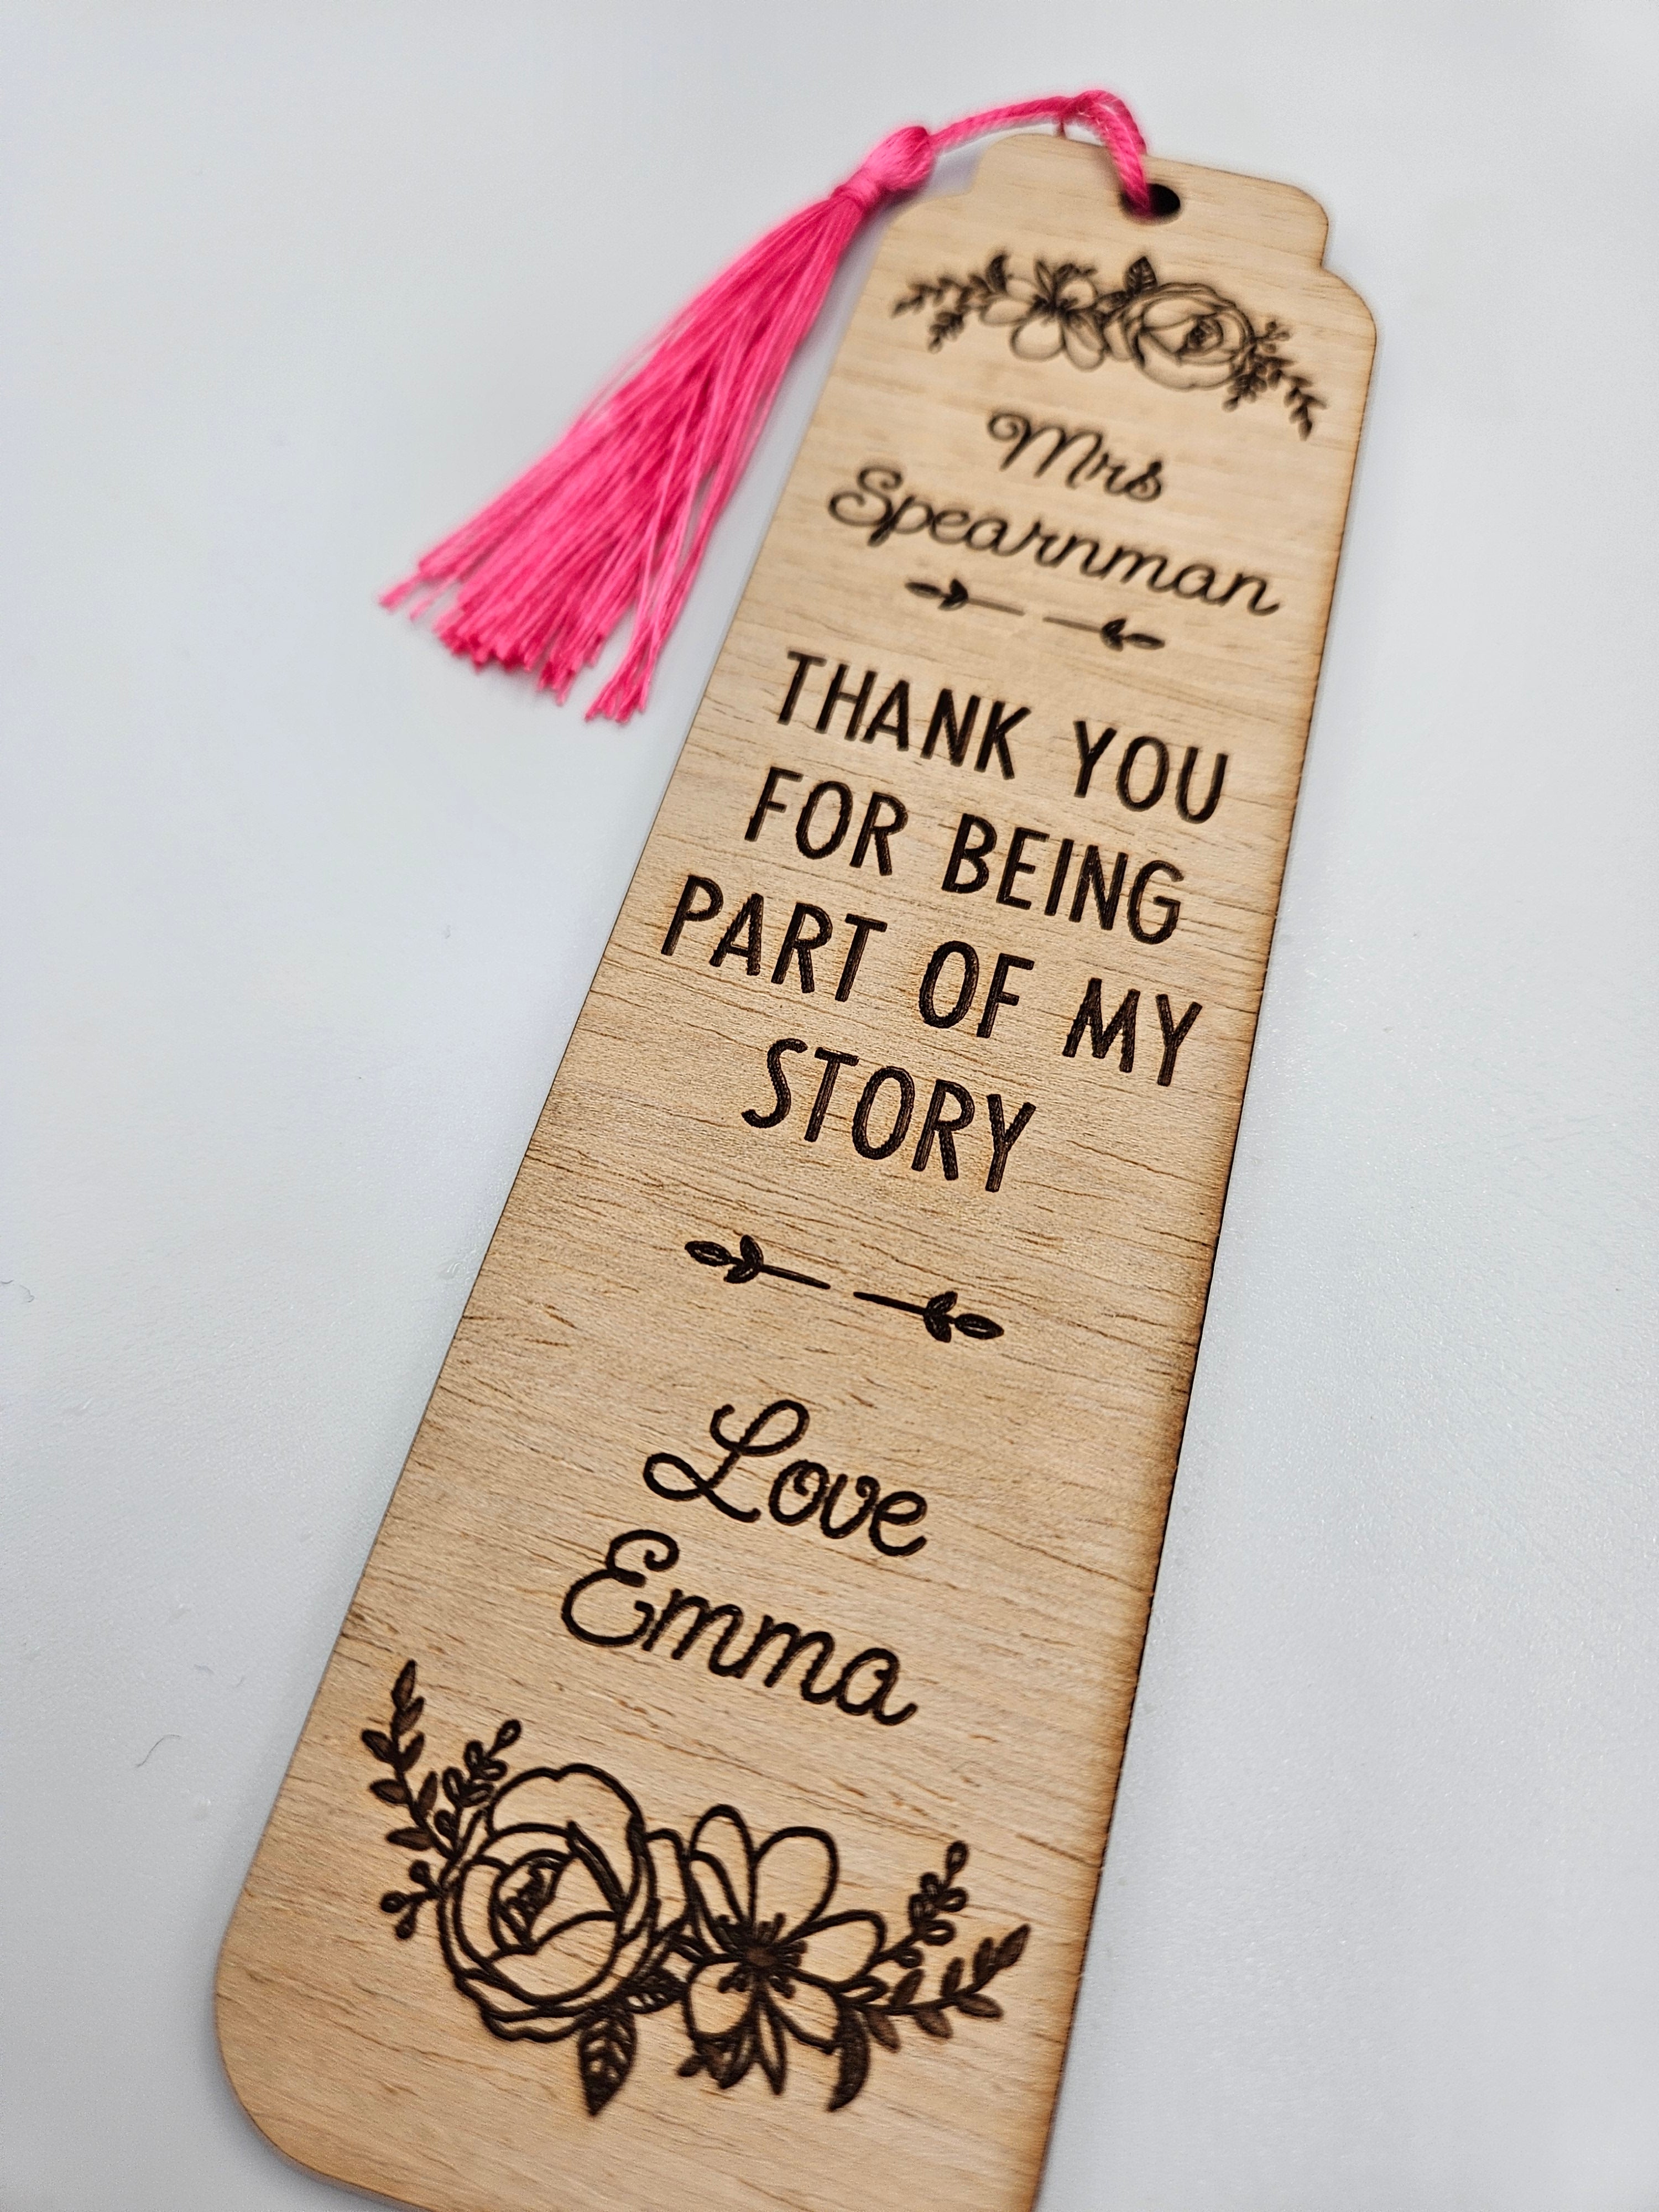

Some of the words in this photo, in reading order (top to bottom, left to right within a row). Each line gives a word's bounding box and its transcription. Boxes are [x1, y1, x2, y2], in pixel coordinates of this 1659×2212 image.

[827, 466, 1280, 615] Spearnman
[987, 411, 1164, 502] Mrs
[776, 649, 1032, 781] THANK
[1072, 719, 1229, 825] YOU
[744, 765, 909, 877] FOR
[941, 812, 1185, 945] BEING
[660, 872, 888, 1003] PART
[917, 940, 1035, 1040] OF
[1063, 977, 1204, 1088] MY
[740, 1037, 1037, 1193] STORY
[642, 1398, 928, 1558] Love
[560, 1528, 919, 1727] Emma
